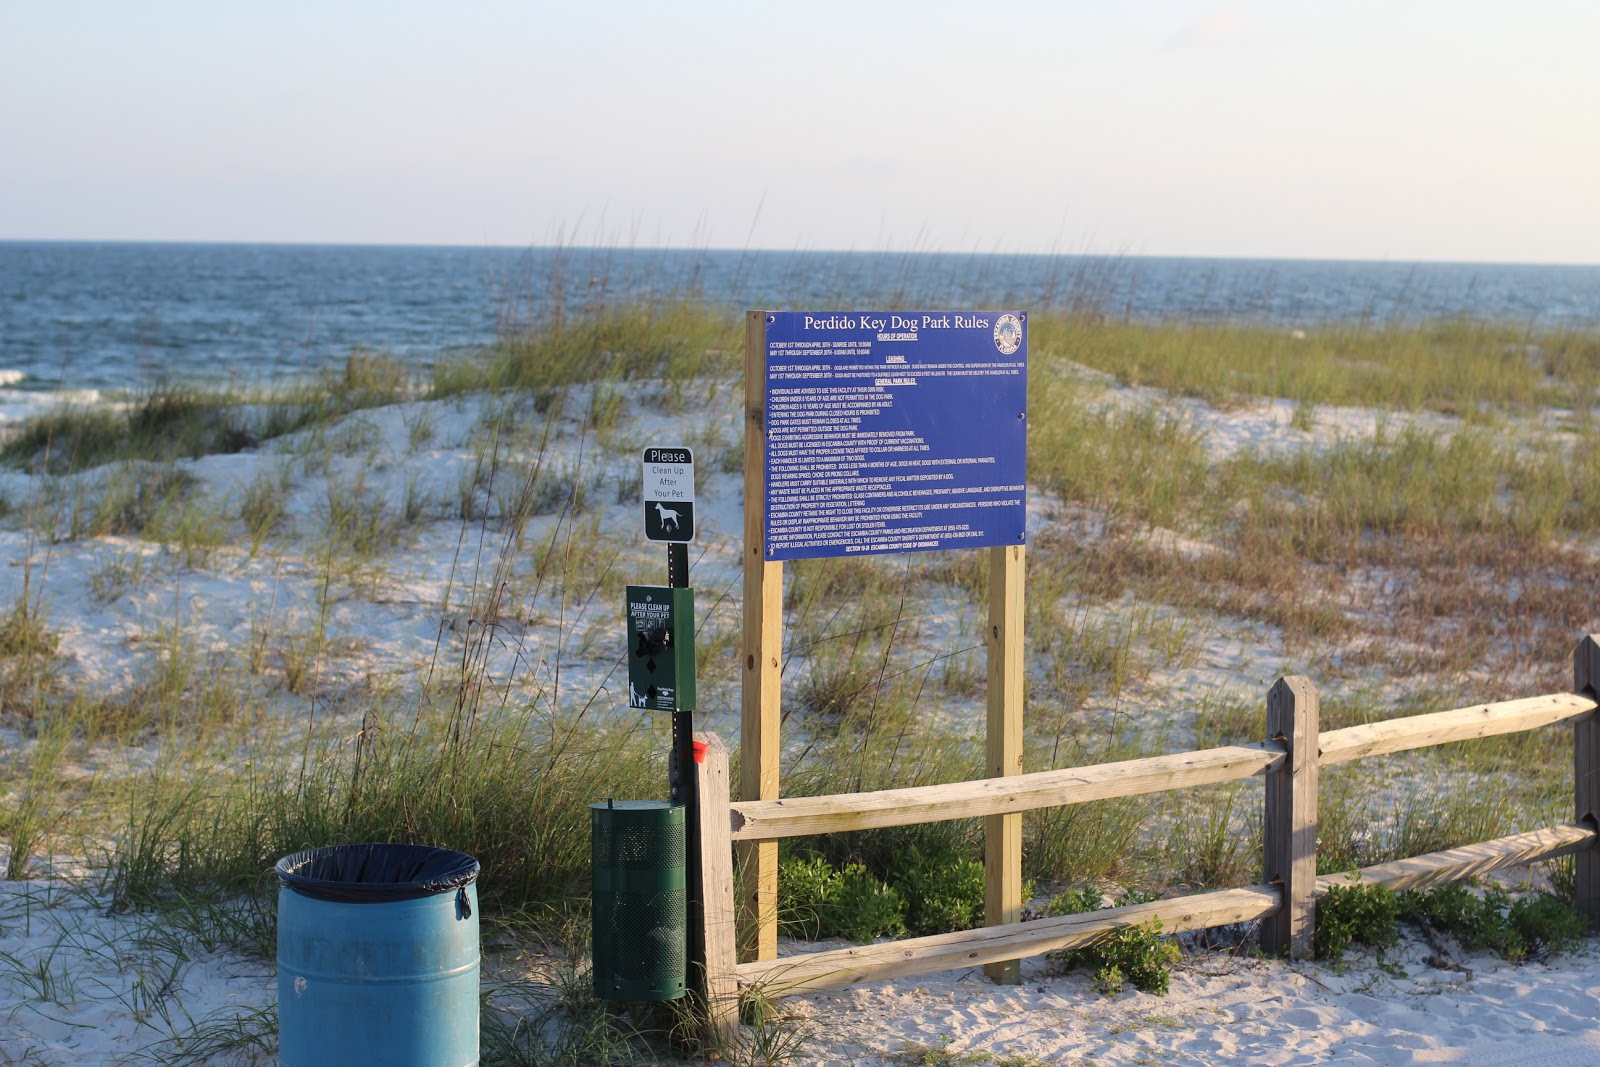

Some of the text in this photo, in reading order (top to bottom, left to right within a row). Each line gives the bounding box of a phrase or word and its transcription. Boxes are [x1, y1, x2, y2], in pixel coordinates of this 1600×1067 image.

[804, 316, 856, 330] Perdido
[860, 316, 885, 332] Key
[891, 316, 918, 331] Dog
[922, 316, 950, 328] Park
[954, 315, 988, 328] Rules
[651, 450, 685, 462] Please
[674, 467, 684, 475] Up
